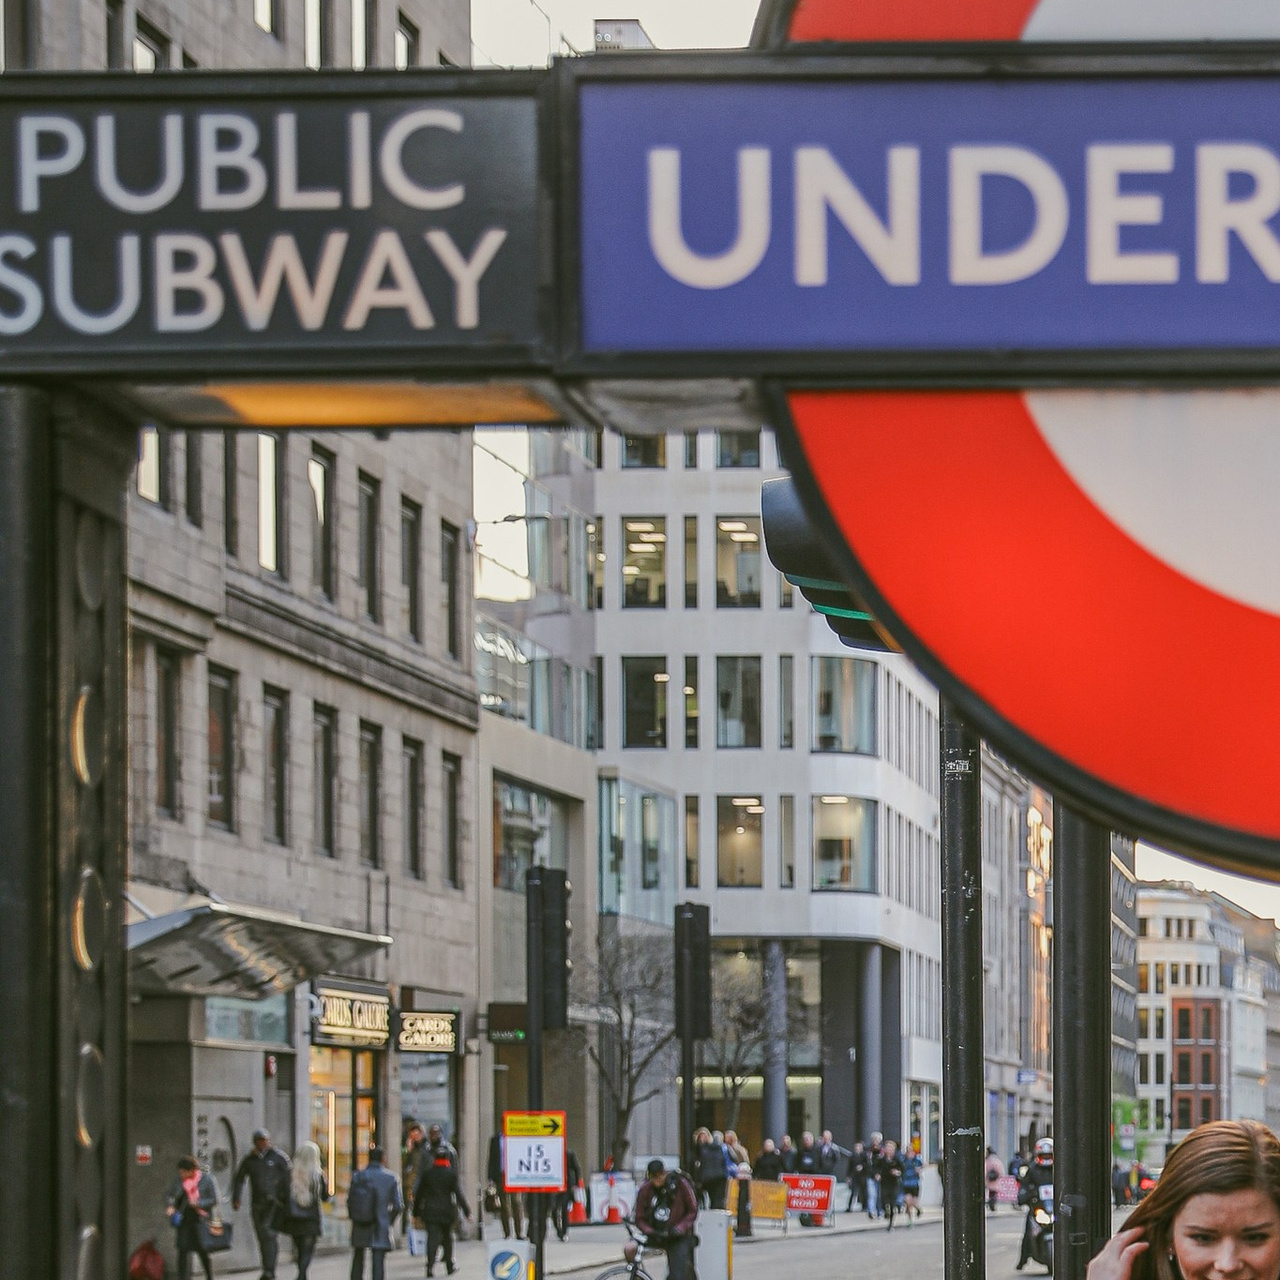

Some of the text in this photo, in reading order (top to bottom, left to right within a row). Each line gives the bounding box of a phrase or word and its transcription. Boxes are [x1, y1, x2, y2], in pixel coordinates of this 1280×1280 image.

[17, 108, 466, 213] PUBLIC
[0, 229, 508, 335] SUBWAY
[399, 1030, 456, 1047] GALORE
[403, 1016, 452, 1032] CARDS
